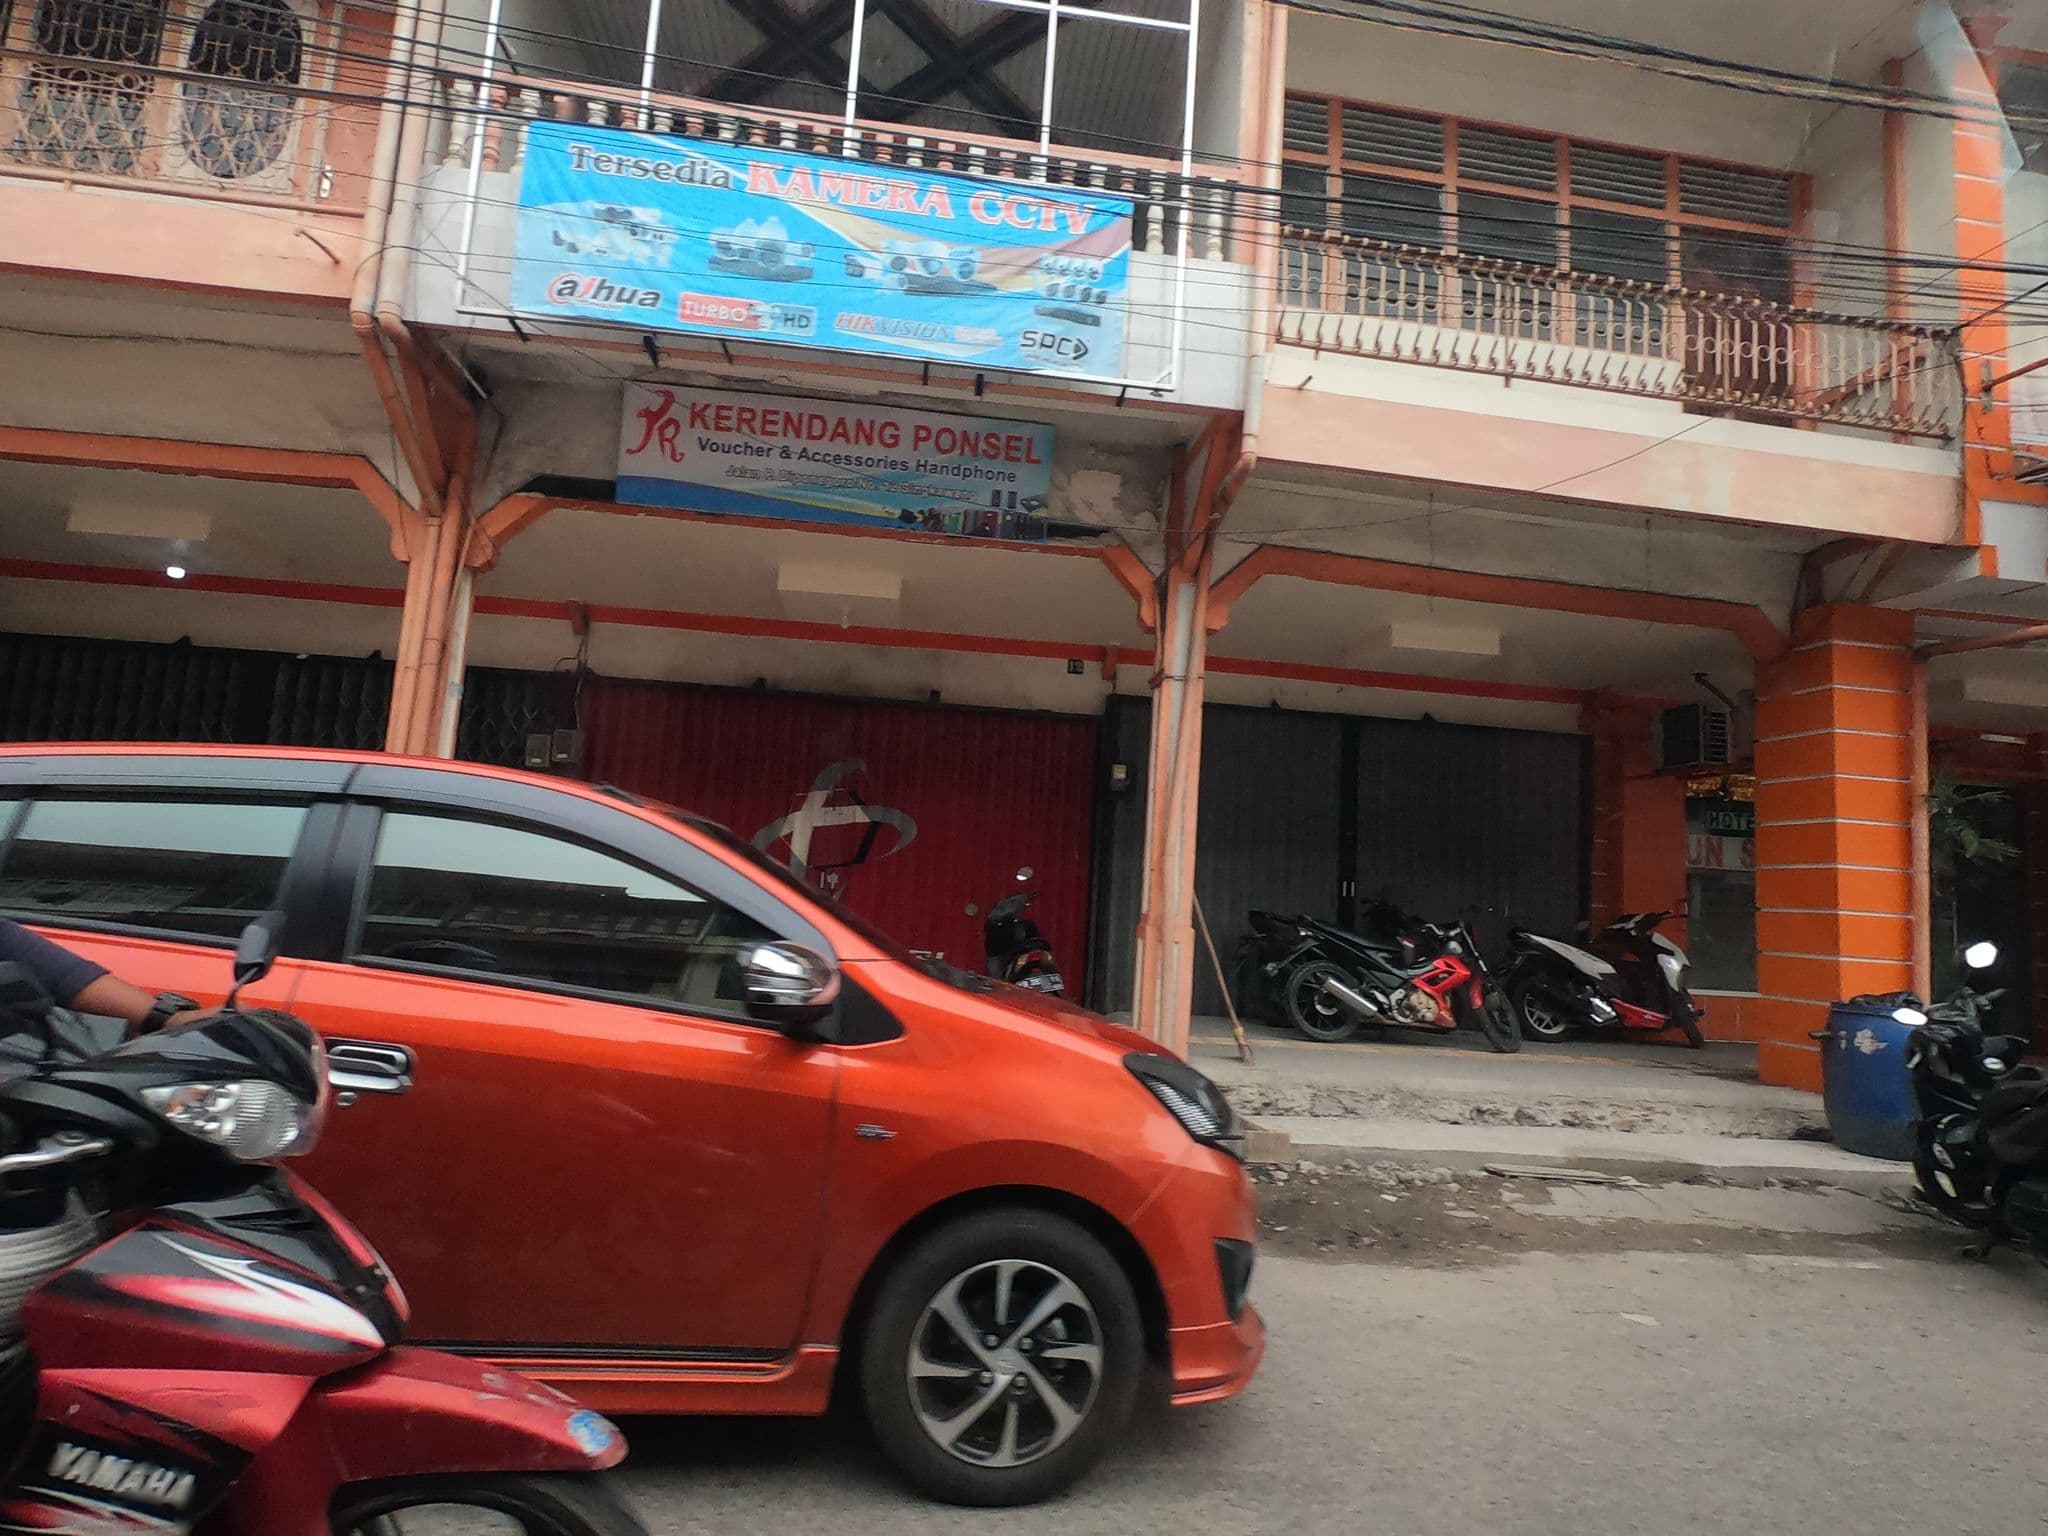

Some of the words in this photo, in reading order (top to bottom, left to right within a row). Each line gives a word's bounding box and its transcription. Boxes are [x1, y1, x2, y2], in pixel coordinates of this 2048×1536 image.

[569, 144, 731, 190] Tersedia
[744, 160, 954, 219] KAMERA
[968, 190, 1098, 235] CCTV
[684, 300, 748, 322] TURBO
[783, 314, 811, 329] HD
[688, 401, 902, 450] KERENDANG
[912, 424, 1042, 465] PONSEL
[698, 436, 772, 460] Voucher
[780, 445, 793, 459] &
[797, 446, 909, 473] Accessories
[915, 459, 1017, 484] Handphone
[47, 1442, 197, 1510] YAMAHA
